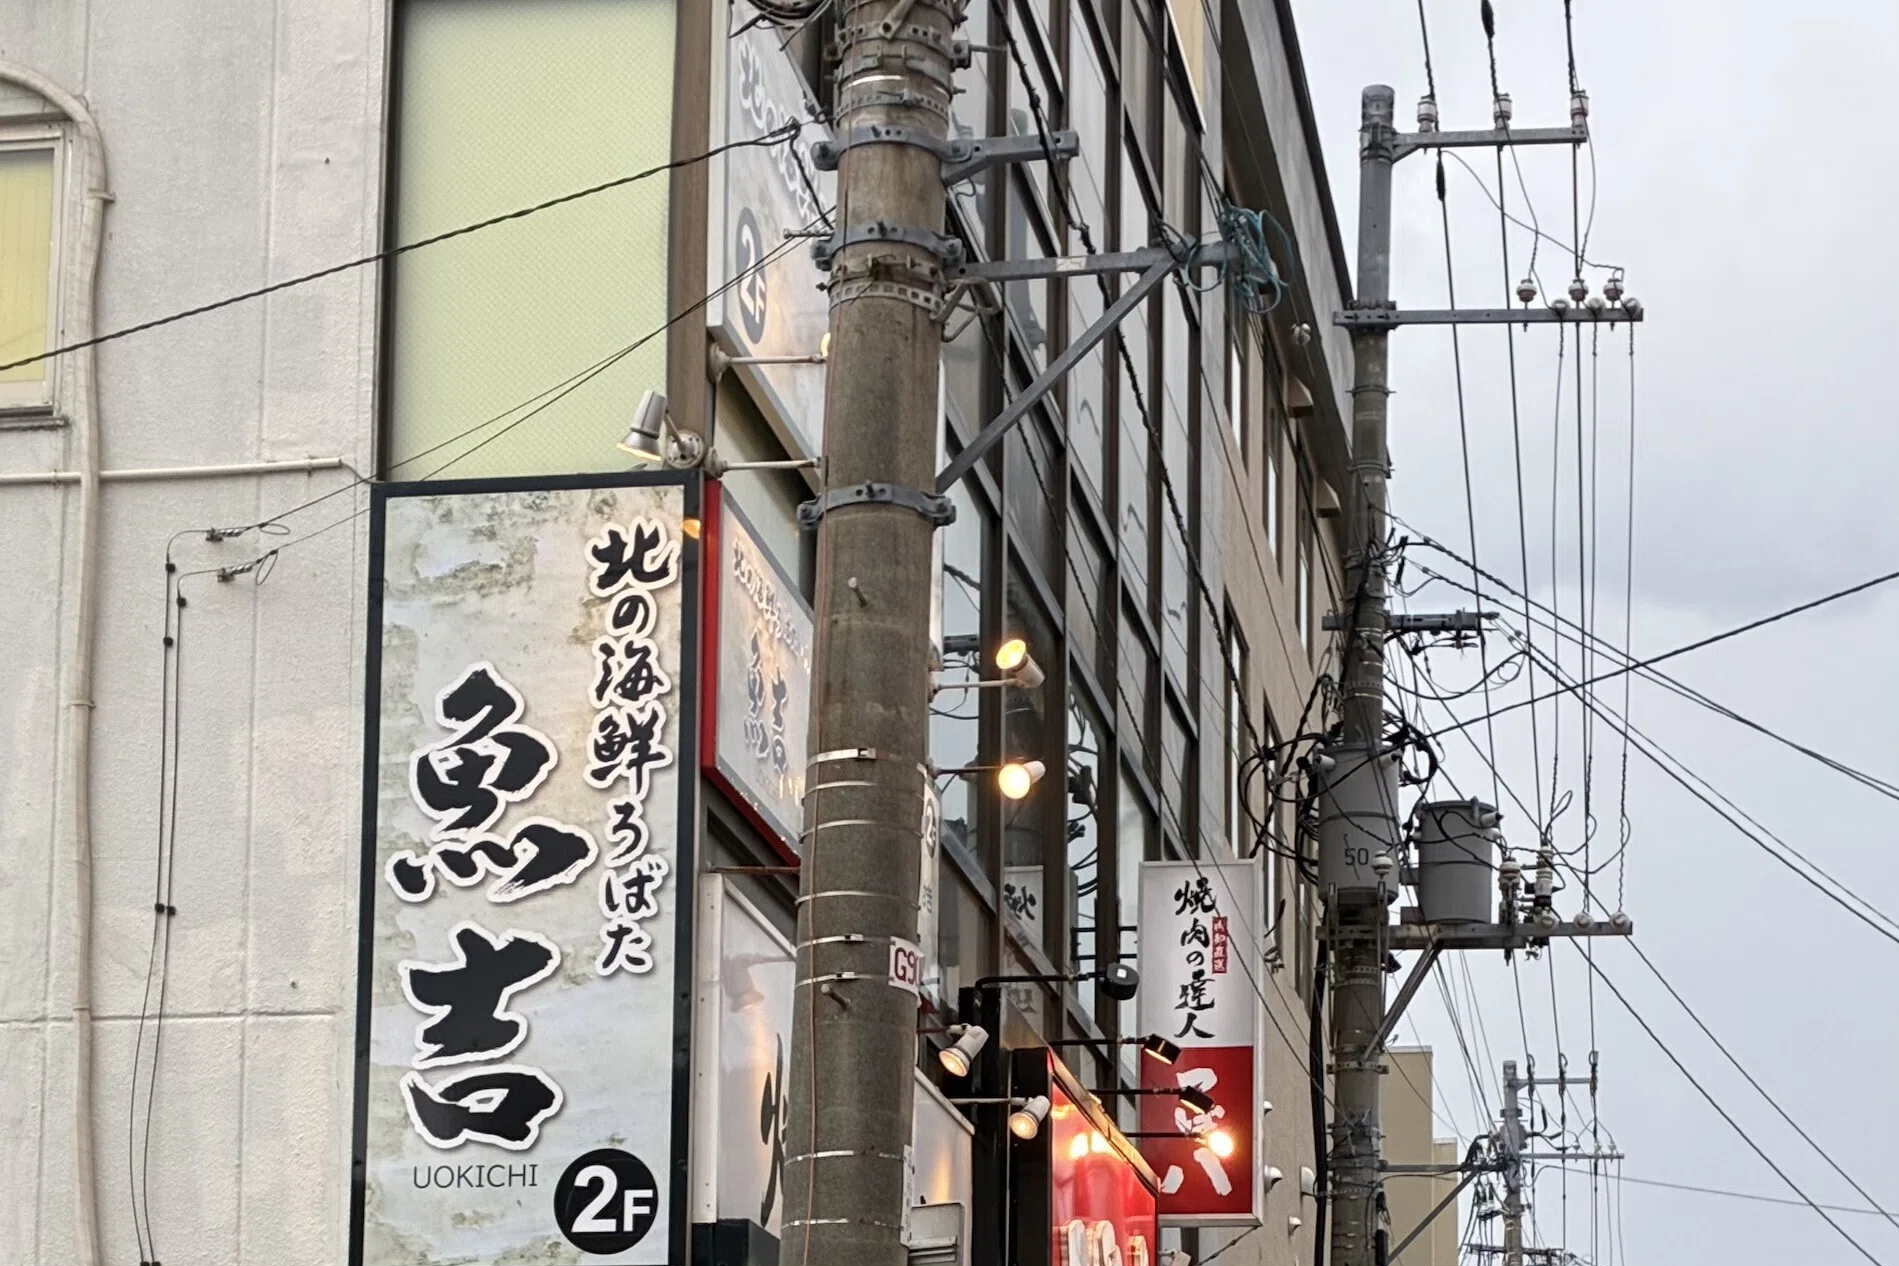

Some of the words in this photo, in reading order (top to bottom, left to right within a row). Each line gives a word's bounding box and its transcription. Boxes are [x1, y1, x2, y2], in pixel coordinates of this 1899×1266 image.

[593, 523, 677, 972] 北の海鮮ろばた
[394, 669, 592, 1144] 魚吉
[1174, 878, 1217, 1039] 焼肉の達人
[413, 1163, 538, 1190] UOKICHI
[572, 1164, 654, 1234] 2F
